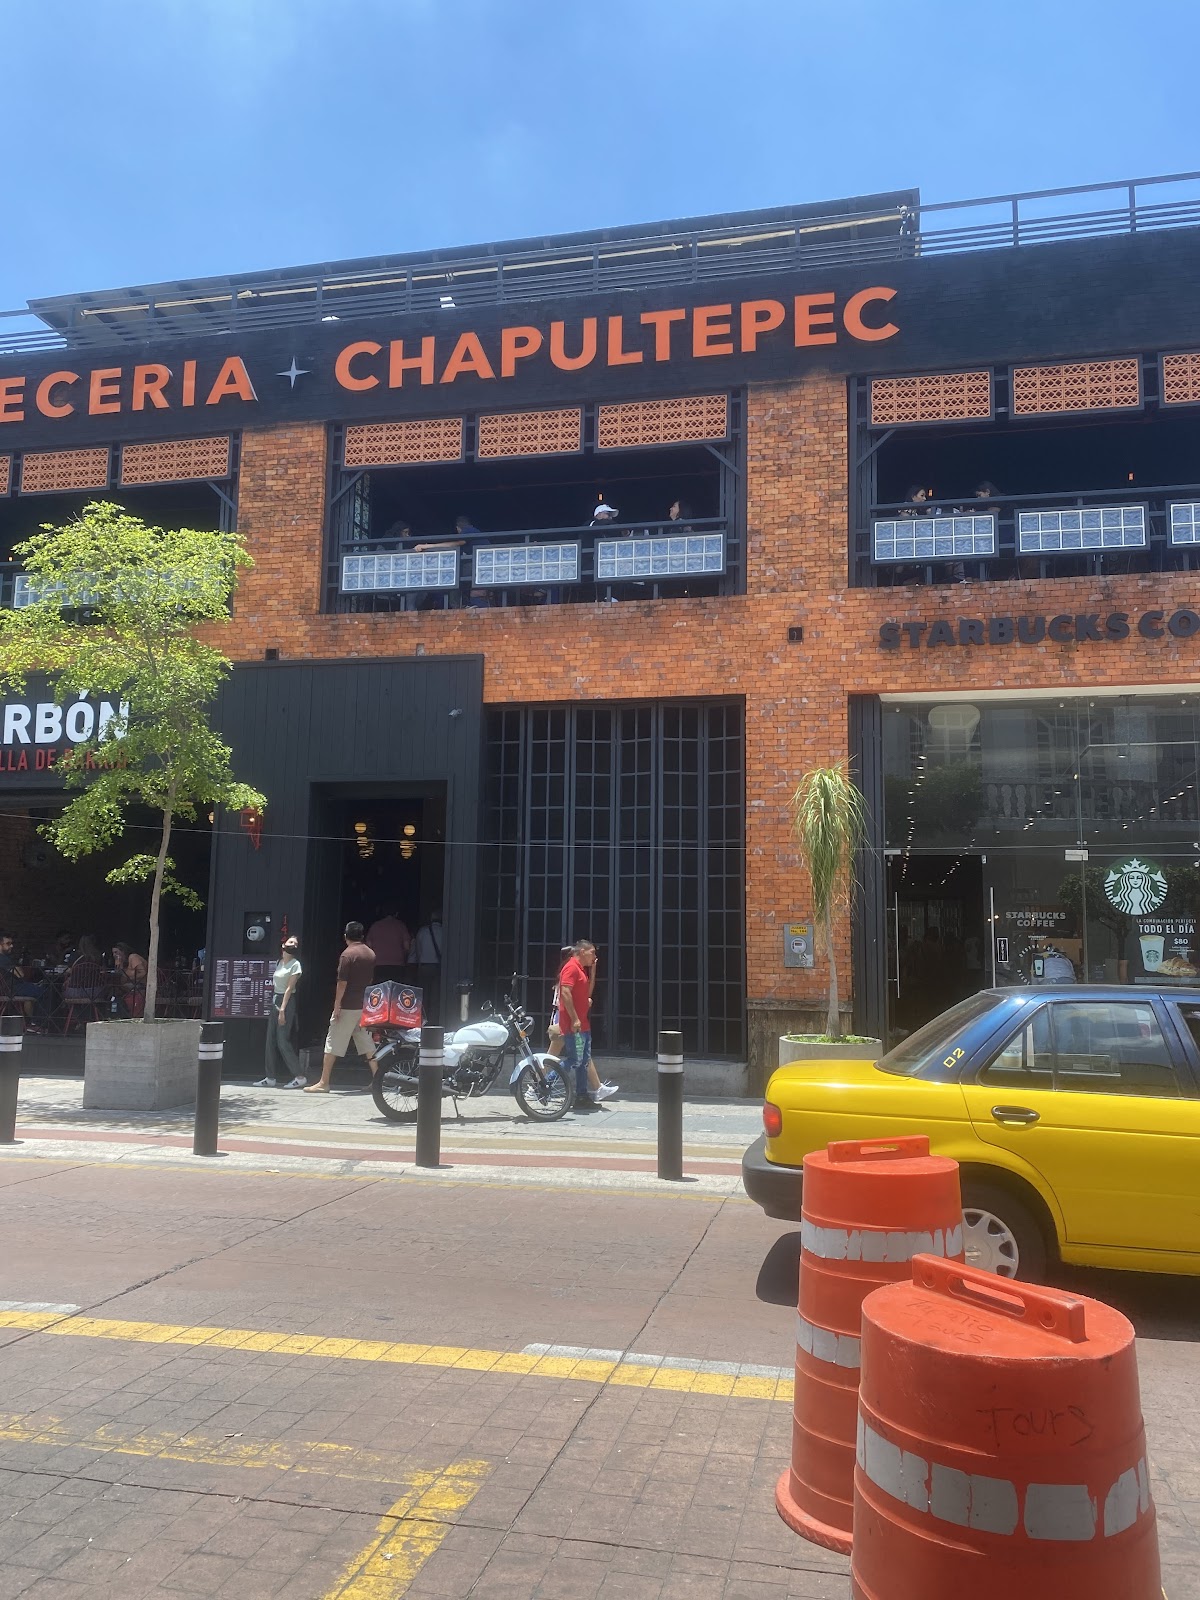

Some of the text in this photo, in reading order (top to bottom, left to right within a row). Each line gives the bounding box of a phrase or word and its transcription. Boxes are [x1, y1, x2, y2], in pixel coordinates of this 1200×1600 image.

[0, 286, 900, 423] ECERIA CHAPULTEPEC
[879, 609, 1200, 649] STARBUCKS CO
[0, 689, 130, 745] RBÓN
[1005, 911, 1066, 920] STARBUCKS
[1016, 919, 1055, 927] COFFEE
[1139, 922, 1195, 934] TODO EL DÍA
[1174, 937, 1189, 945] $80
[943, 1047, 966, 1068] 02
